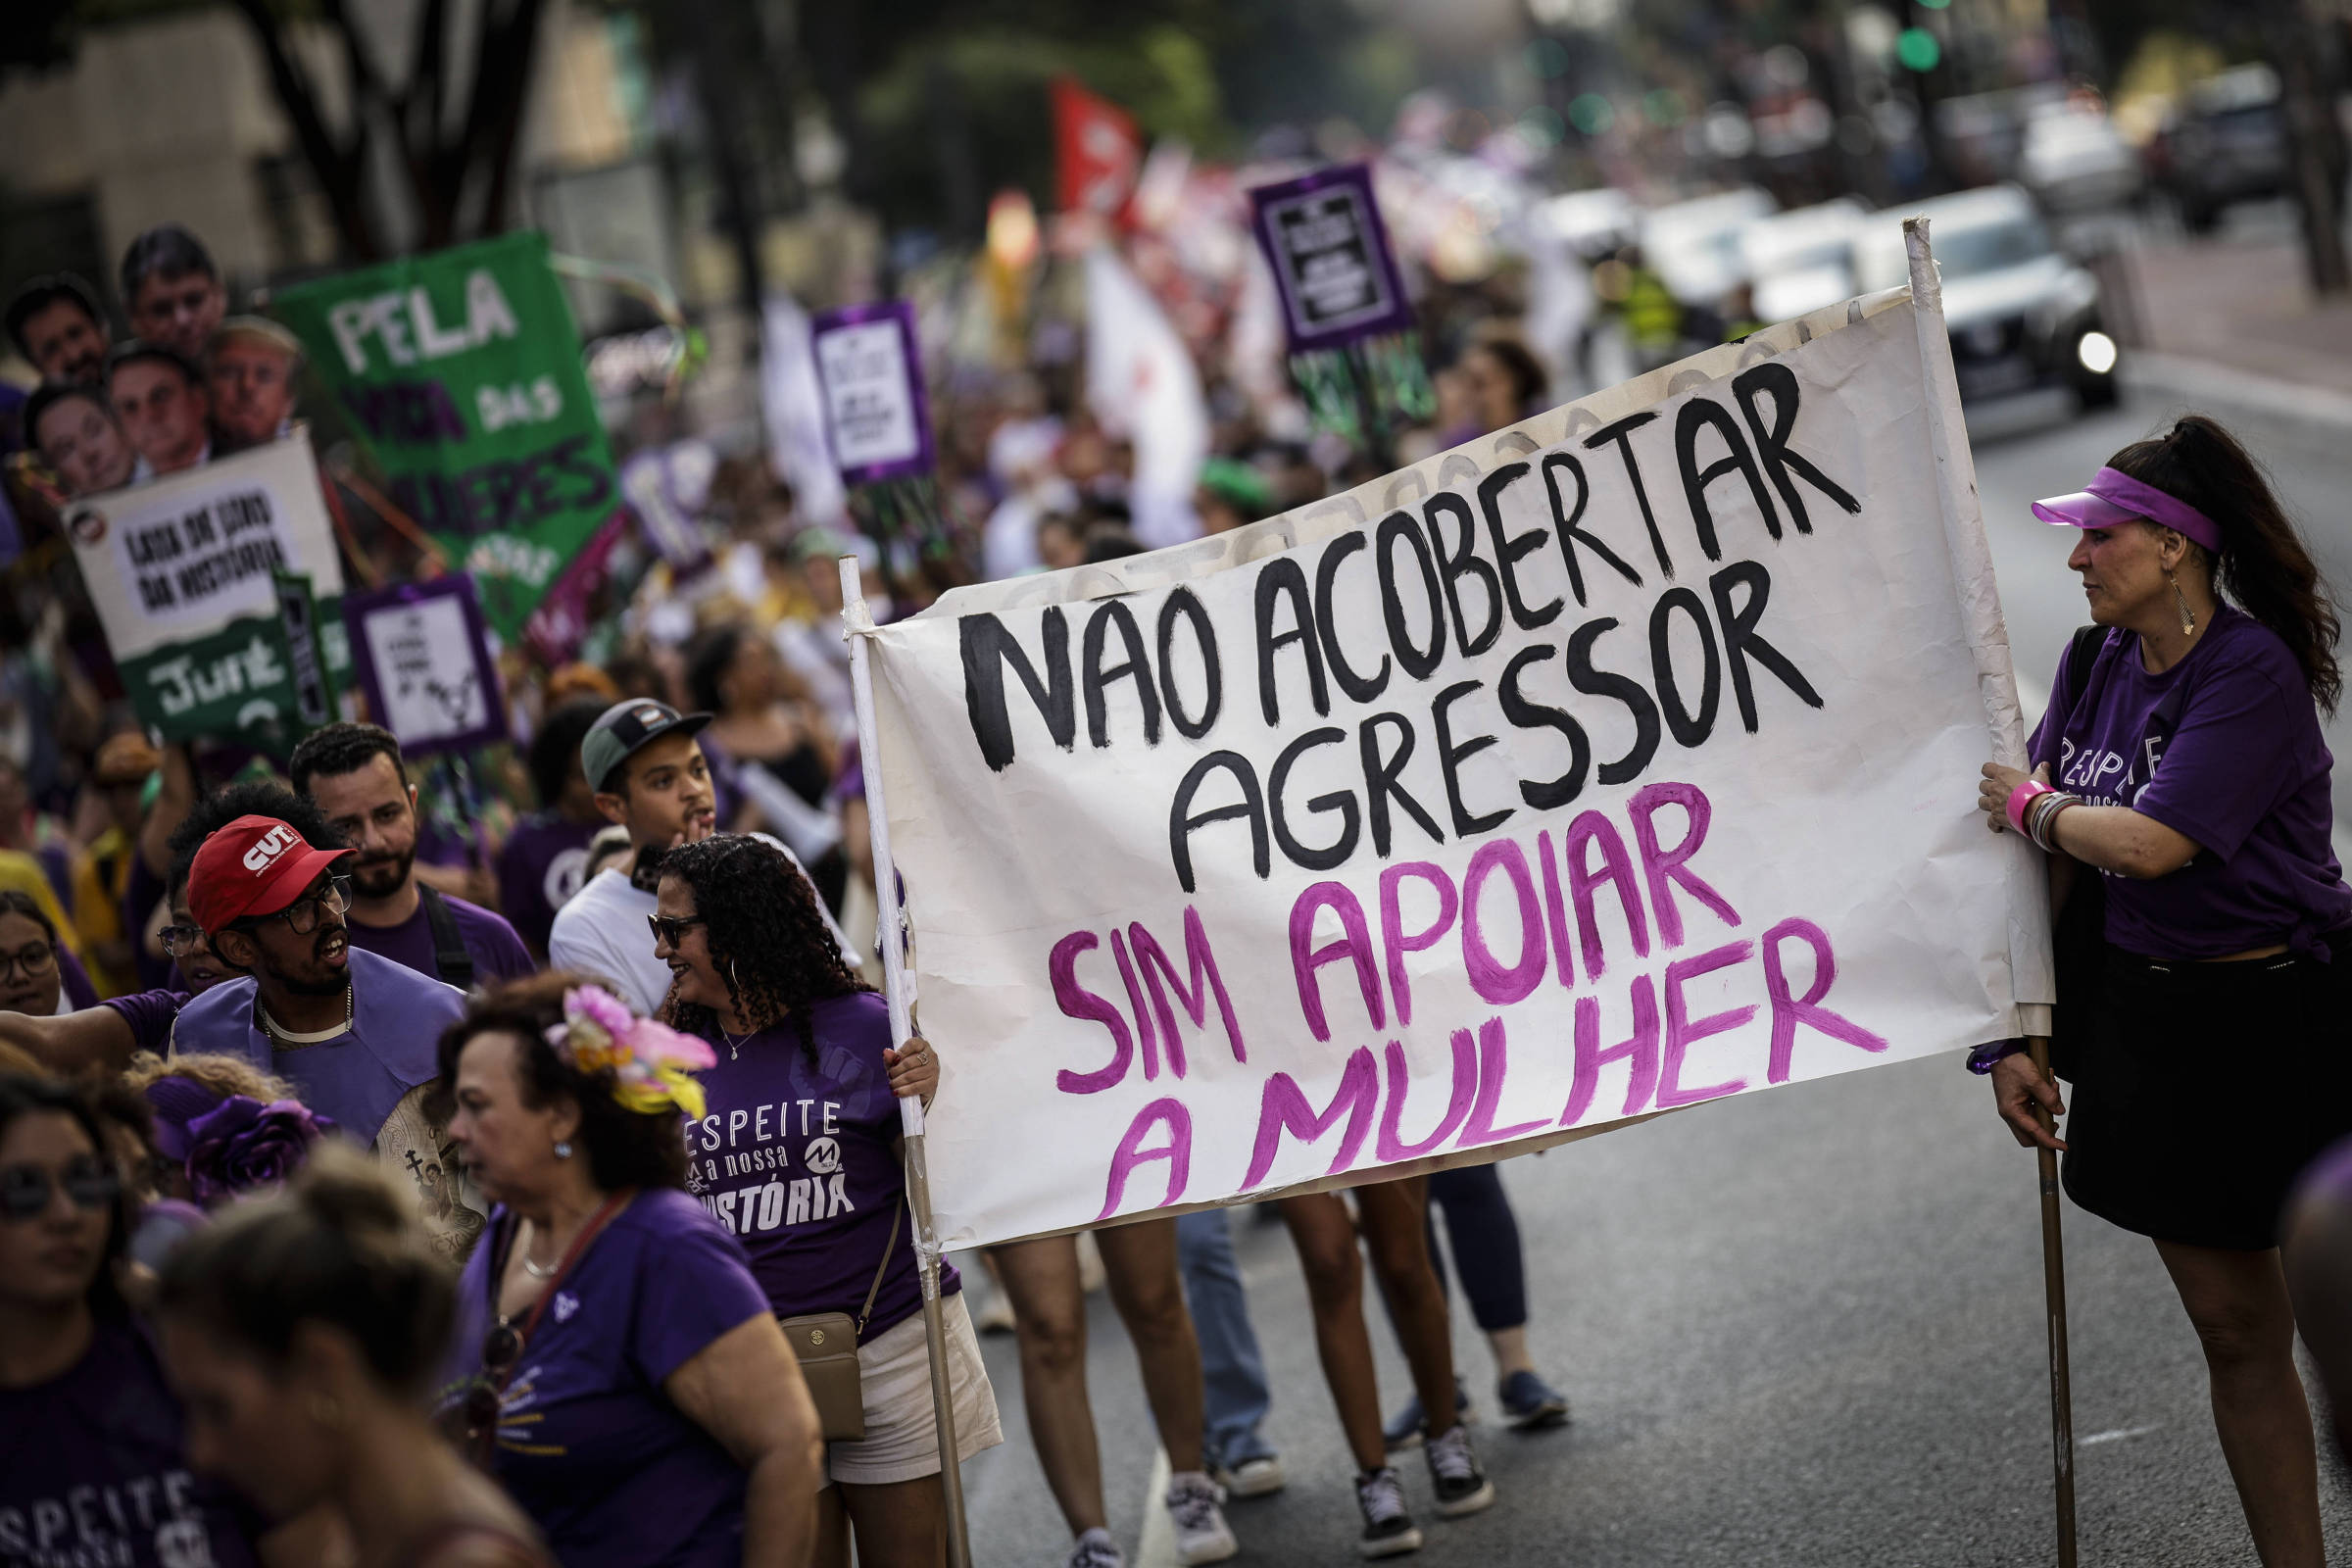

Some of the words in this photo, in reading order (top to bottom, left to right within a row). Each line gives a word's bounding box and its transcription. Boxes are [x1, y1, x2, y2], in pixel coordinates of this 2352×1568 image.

[328, 270, 517, 372] PELA
[1254, 362, 1861, 727] ACOBERTAR
[1169, 560, 1824, 892] AGRESSOR
[243, 825, 294, 870] CUT
[1049, 906, 1248, 1095] SIM
[1289, 782, 1741, 1043] APOIAR
[1094, 1098, 1193, 1221] A
[1240, 917, 1889, 1194] MULHER
[683, 1099, 841, 1158] ESPEITE
[705, 1159, 719, 1182] a
[724, 1145, 789, 1178] nossa
[698, 1172, 856, 1237] ISTÓRIA
[0, 1471, 202, 1555] SPEITE
